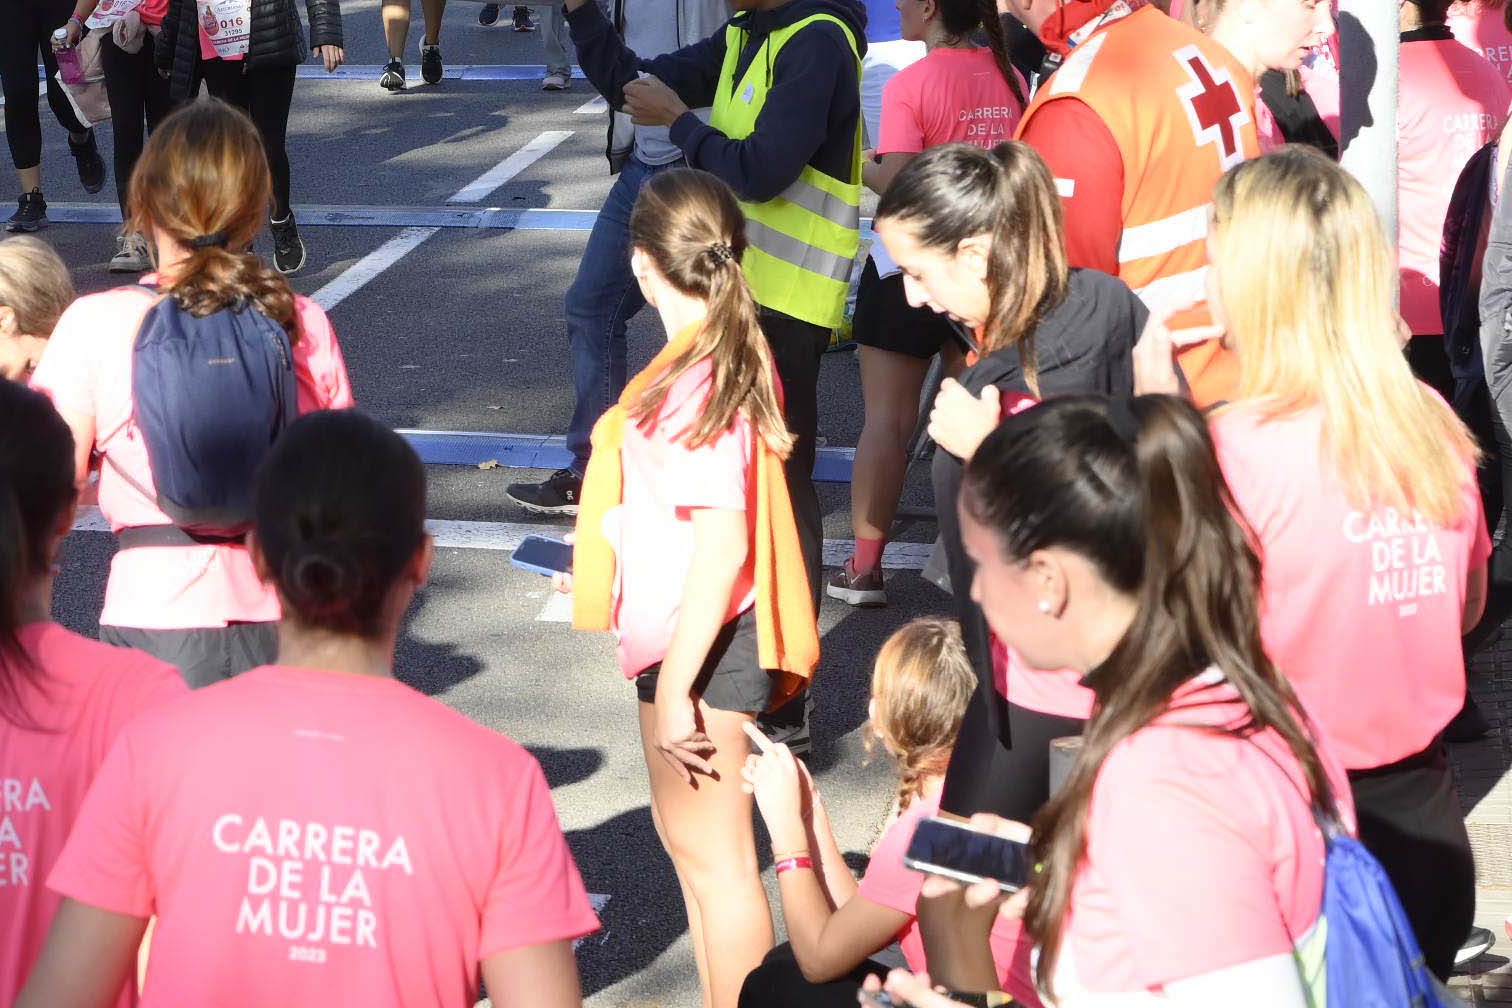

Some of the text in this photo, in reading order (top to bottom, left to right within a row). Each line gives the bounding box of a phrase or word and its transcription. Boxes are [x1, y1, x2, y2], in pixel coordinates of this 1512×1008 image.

[220, 17, 244, 29] 016
[967, 123, 1004, 136] DE LA
[1372, 534, 1443, 572] DE LA
[1368, 564, 1447, 606] MUJER
[212, 812, 414, 875] CARRERA
[247, 856, 373, 907] DE LA
[235, 895, 378, 949] MUJER
